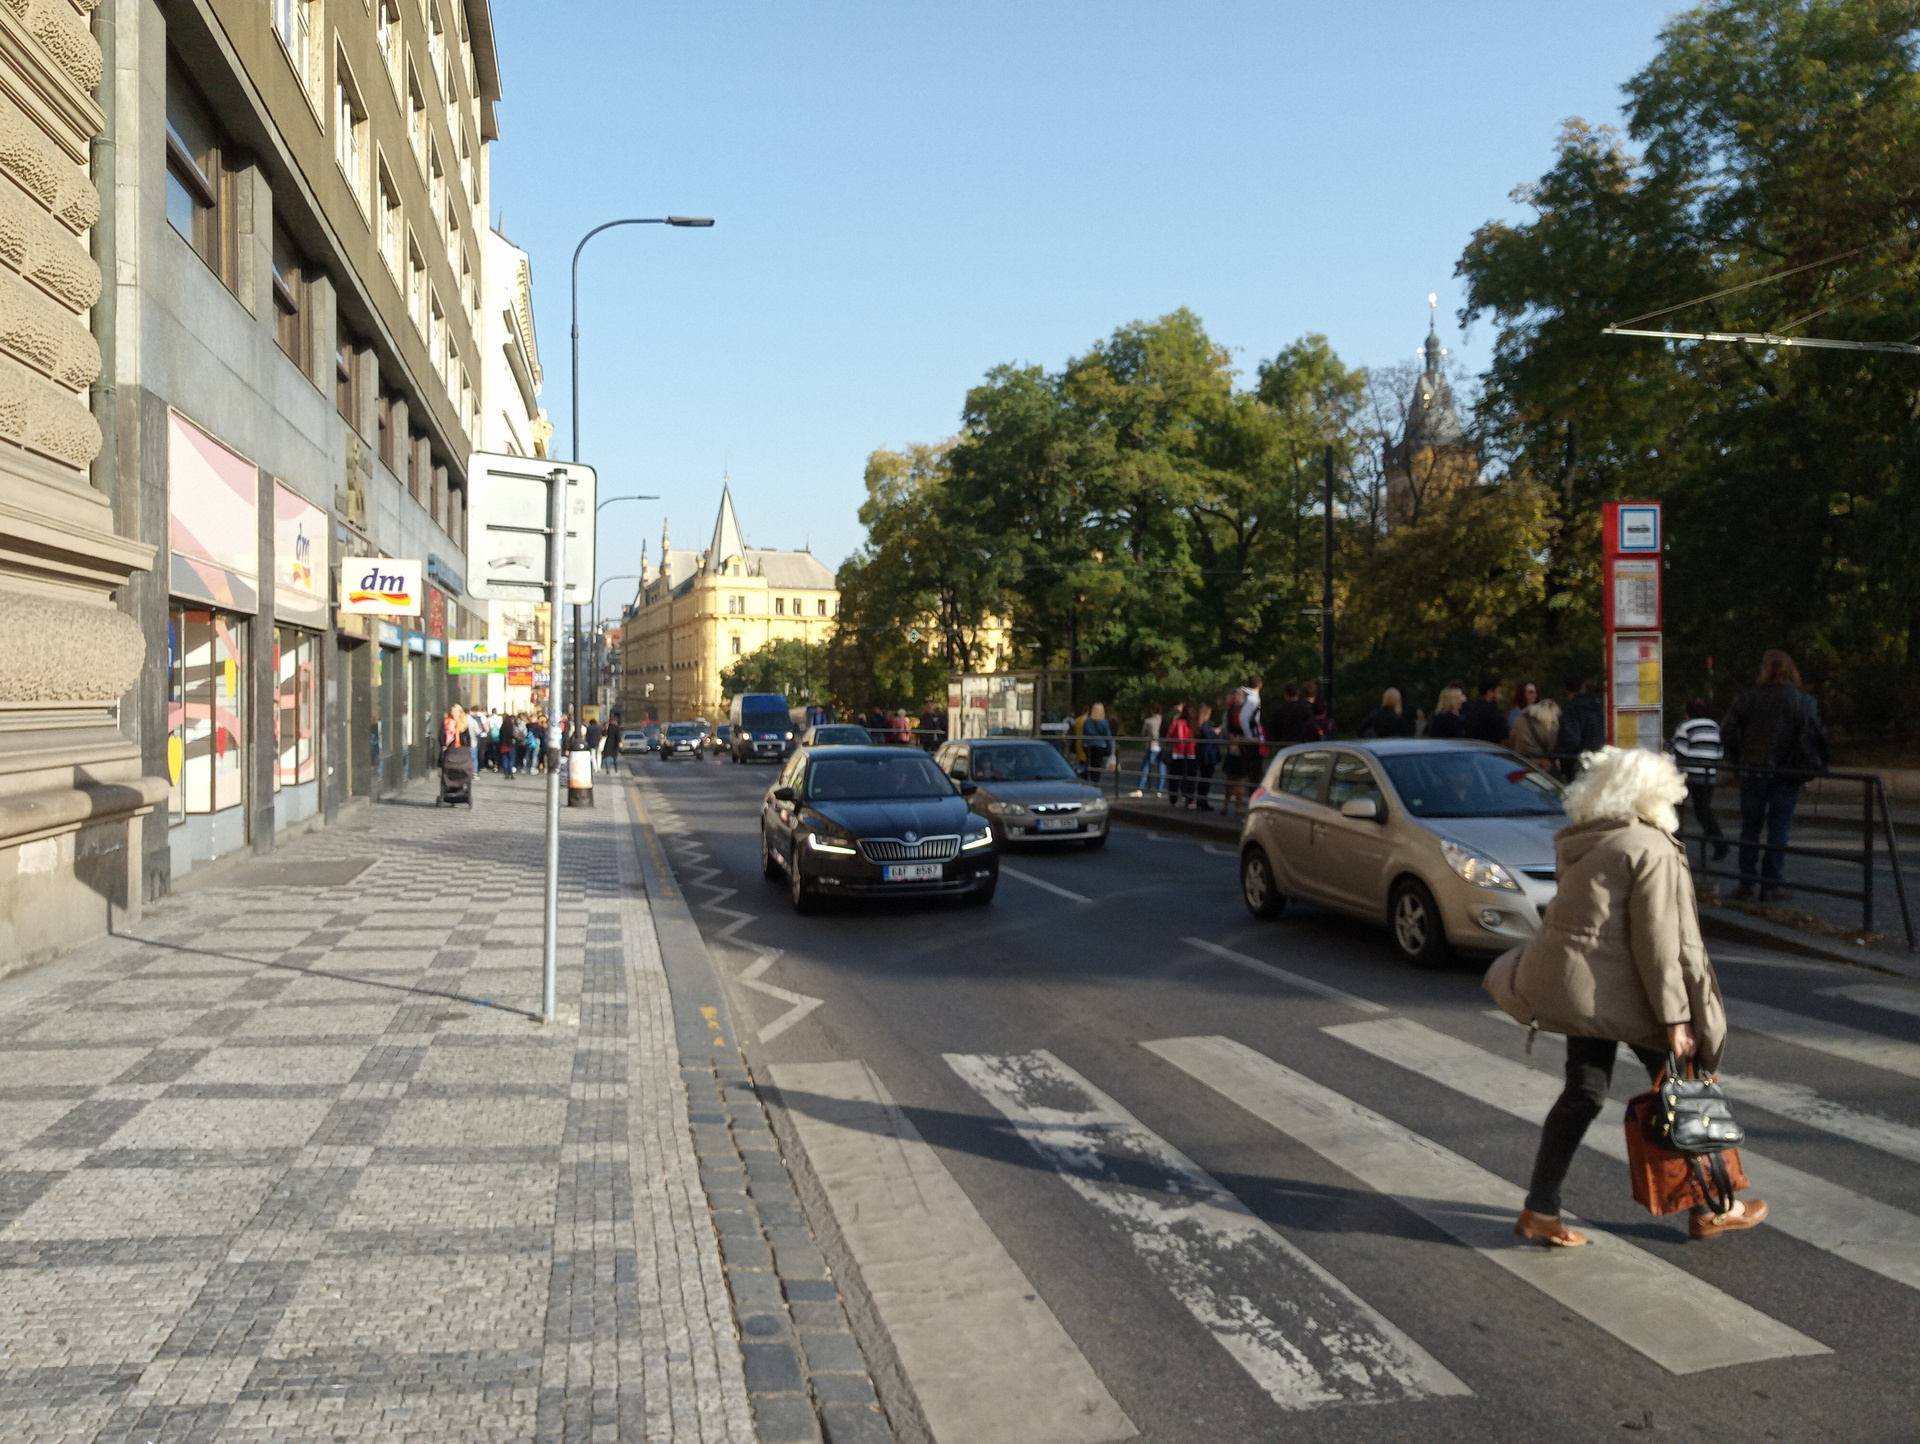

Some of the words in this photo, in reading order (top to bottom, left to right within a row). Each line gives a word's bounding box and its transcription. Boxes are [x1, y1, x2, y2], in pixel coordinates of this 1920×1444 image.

[296, 522, 310, 563] dm
[360, 567, 405, 592] dm
[457, 652, 499, 663] albert
